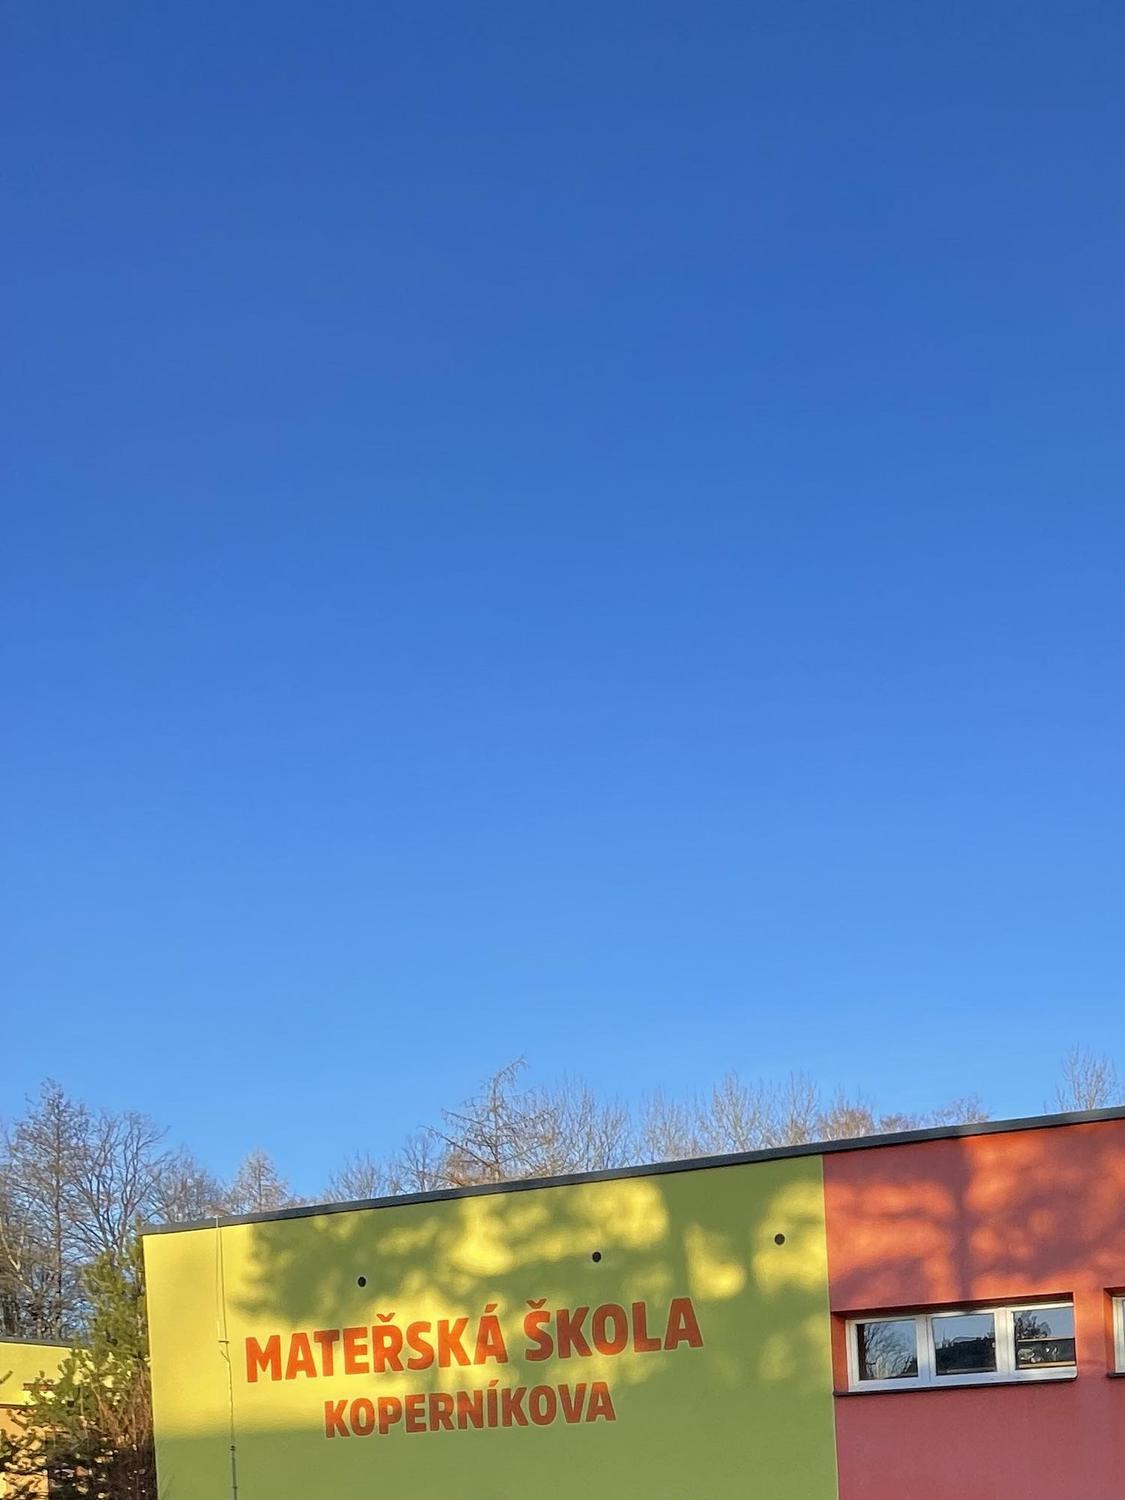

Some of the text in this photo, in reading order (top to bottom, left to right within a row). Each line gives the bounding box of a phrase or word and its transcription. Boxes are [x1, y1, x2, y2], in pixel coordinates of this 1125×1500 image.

[245, 1297, 704, 1383] MATEŘSKÁ ŠKOLA
[324, 1379, 617, 1439] KOPERNÍKOVA
